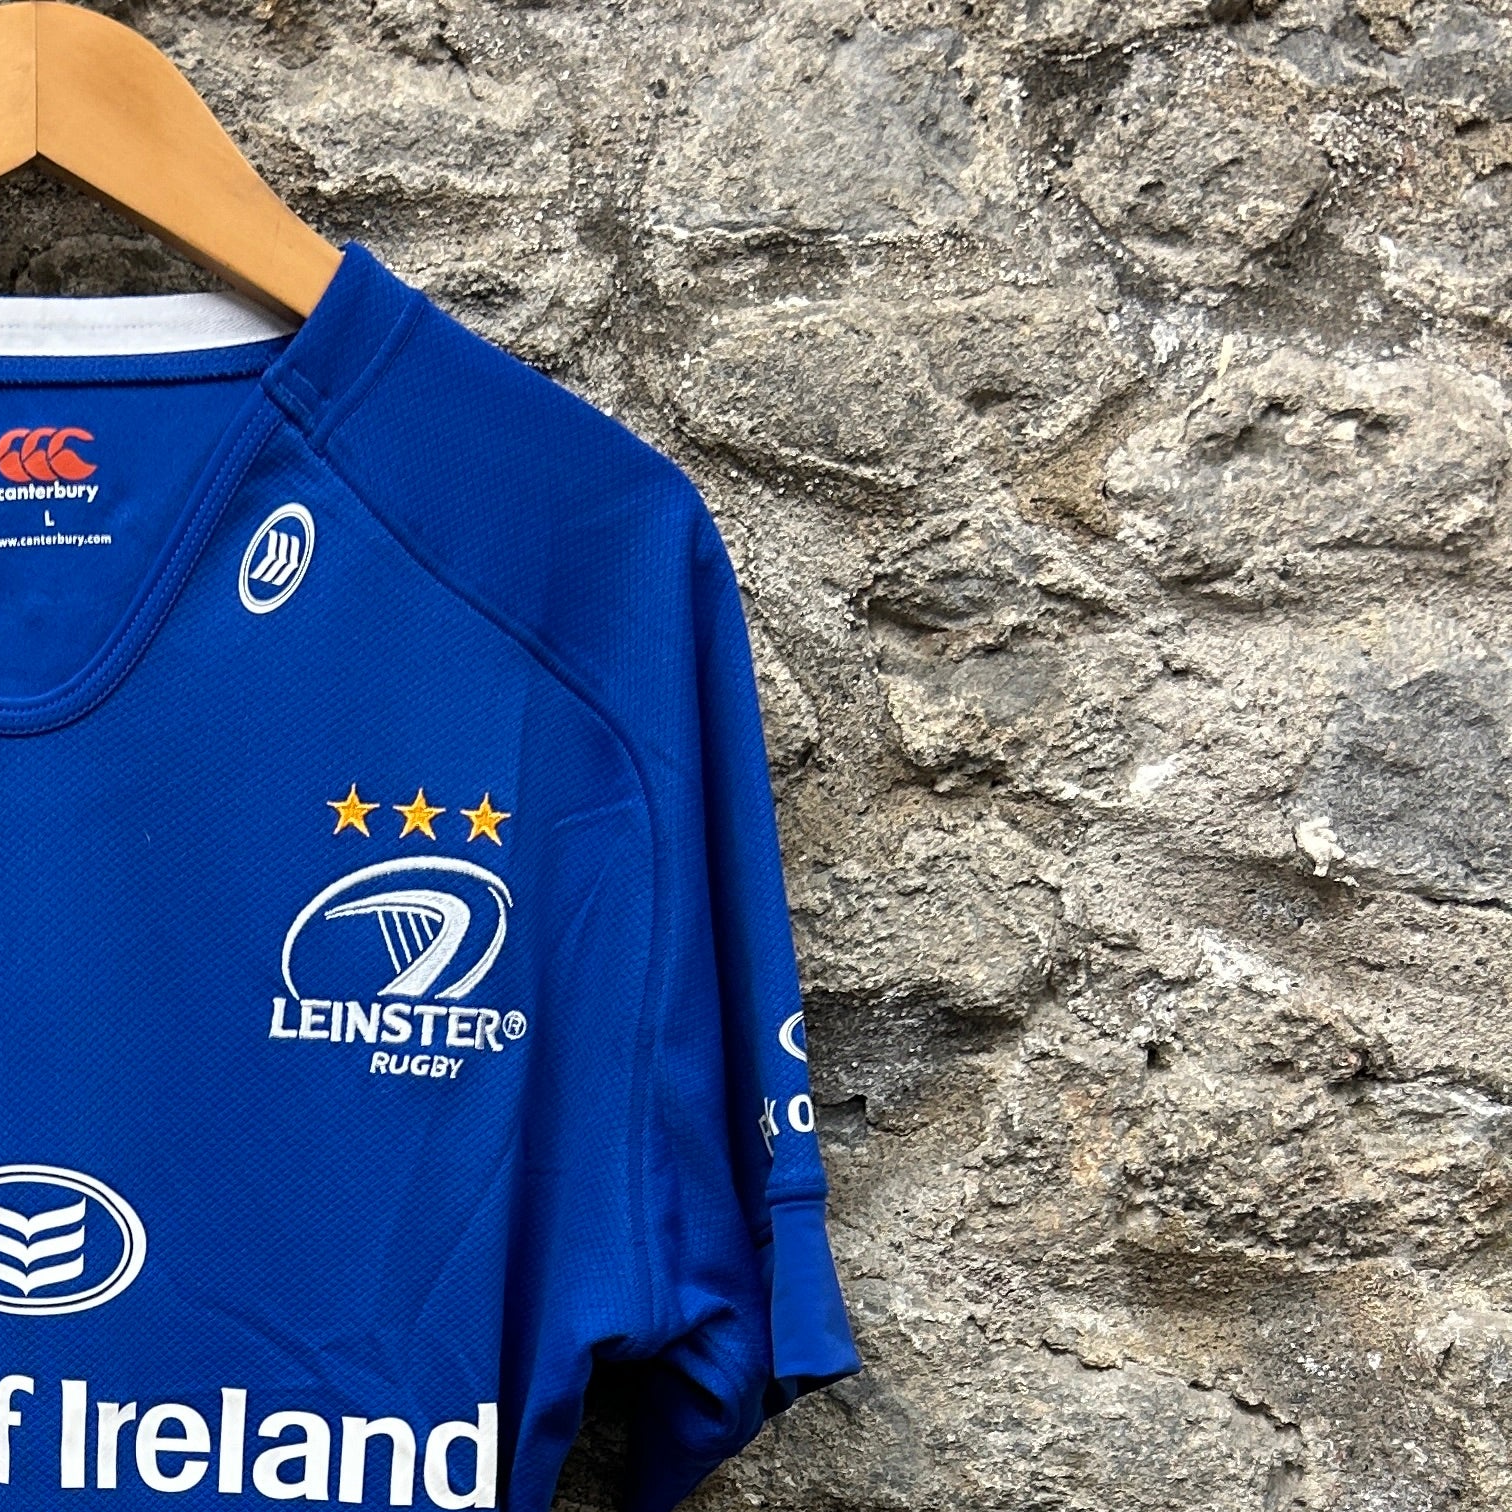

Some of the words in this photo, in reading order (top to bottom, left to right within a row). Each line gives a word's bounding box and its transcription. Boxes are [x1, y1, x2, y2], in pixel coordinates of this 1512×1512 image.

[44, 509, 55, 527] L
[369, 1051, 464, 1079] RUGBY
[60, 1379, 499, 1510] Ireland
